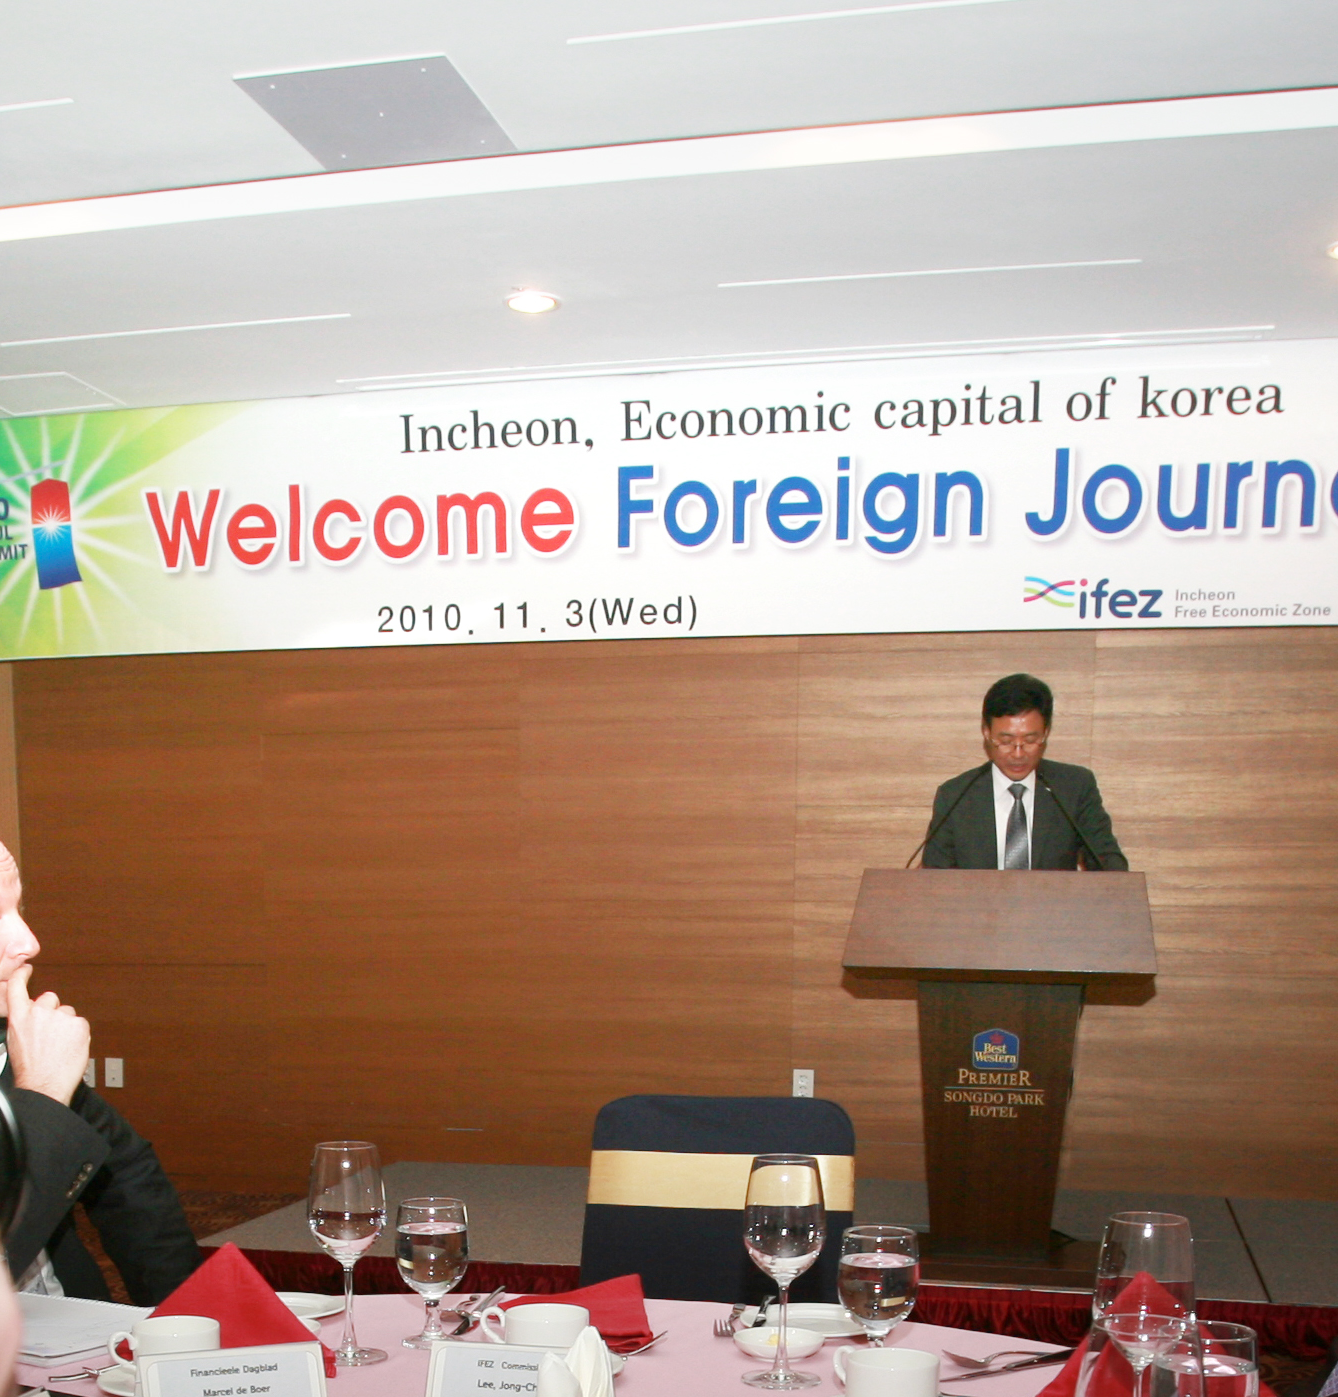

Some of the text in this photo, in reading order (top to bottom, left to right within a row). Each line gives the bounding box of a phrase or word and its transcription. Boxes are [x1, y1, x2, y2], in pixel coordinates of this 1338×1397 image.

[399, 374, 1285, 453] Incheon, Economic capital of korea
[145, 484, 575, 568] Welcome
[617, 455, 984, 555] Foreign
[1079, 578, 1163, 619] ifez
[1174, 588, 1236, 601] Incheon
[1174, 603, 1332, 618] Free Economic Zone
[983, 1042, 1007, 1055] Best
[974, 1051, 1017, 1063] Western
[944, 1091, 1045, 1106] SONGDO PARK
[969, 1105, 1018, 1118] HOTEL
[202, 1384, 271, 1397] Marcel de Boer
